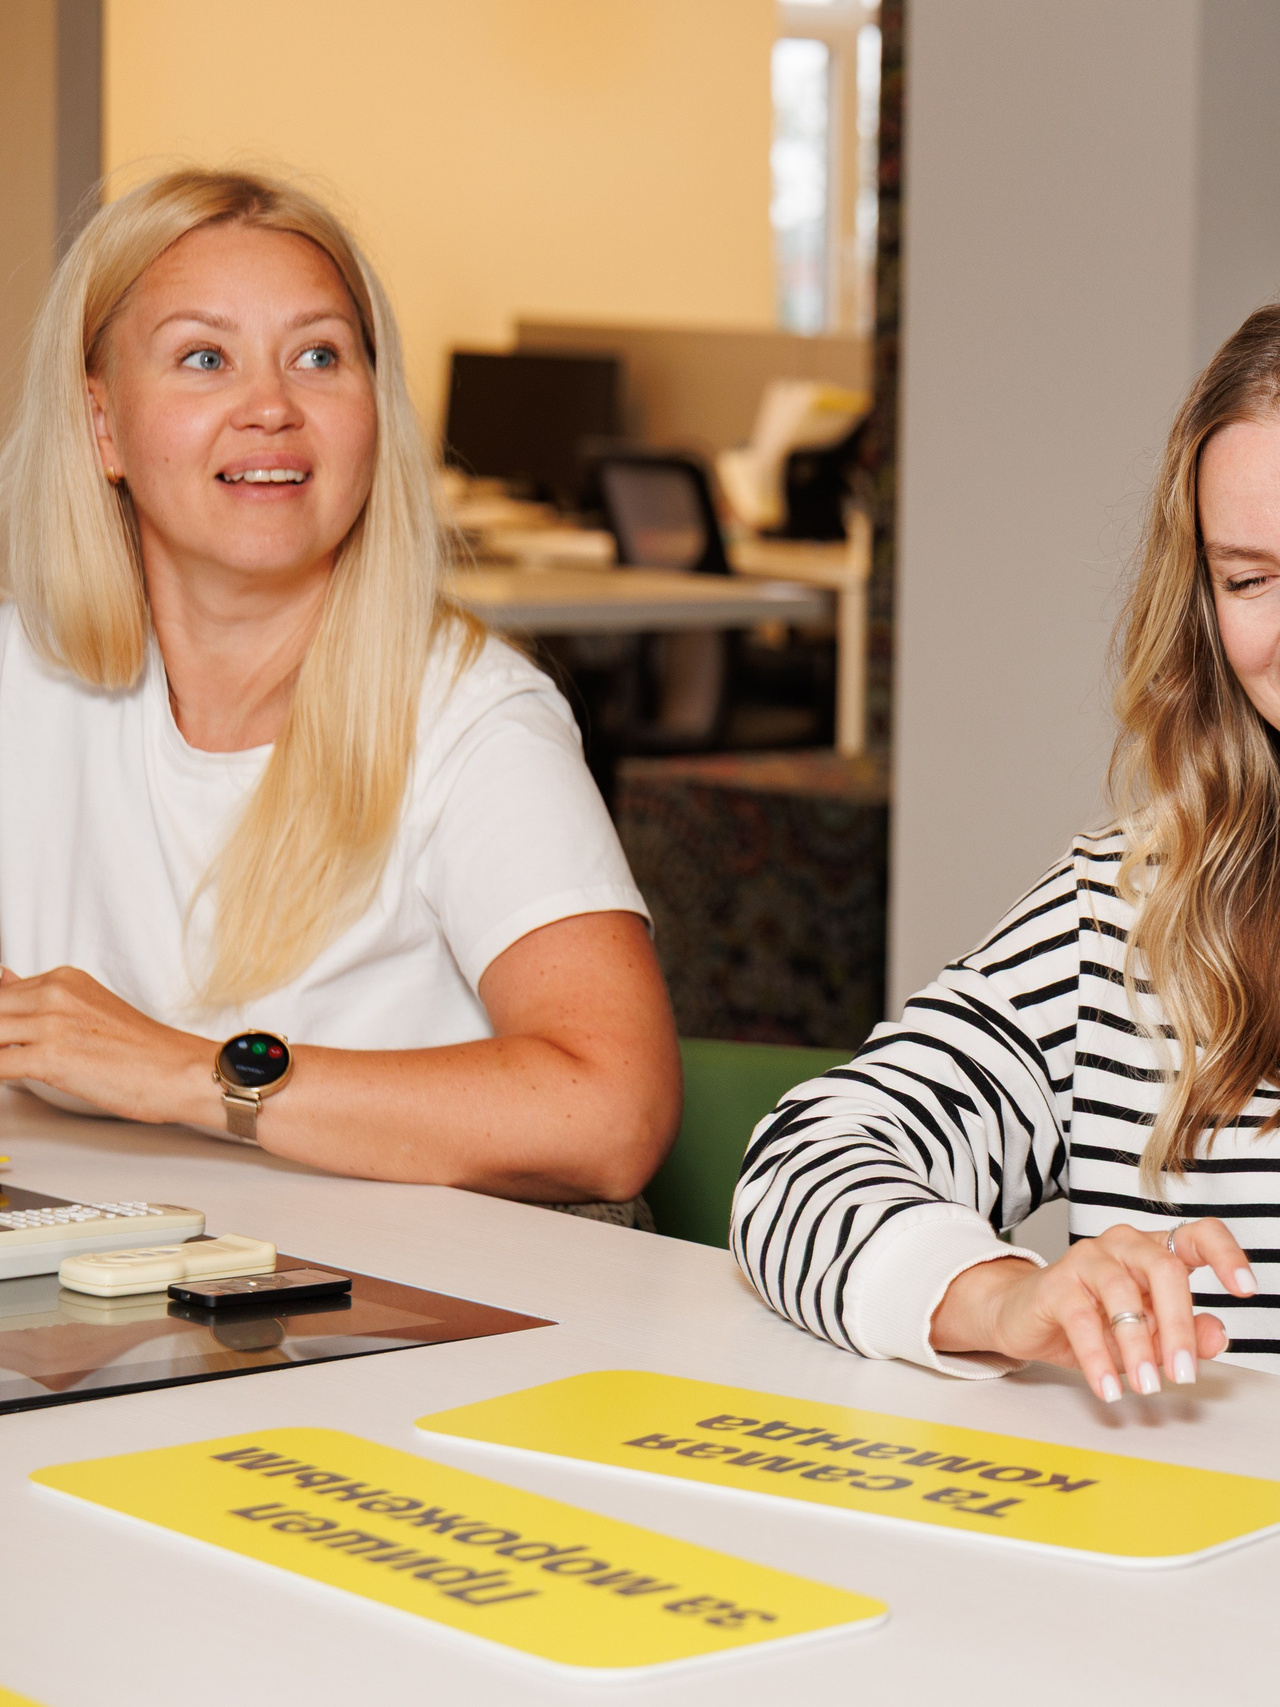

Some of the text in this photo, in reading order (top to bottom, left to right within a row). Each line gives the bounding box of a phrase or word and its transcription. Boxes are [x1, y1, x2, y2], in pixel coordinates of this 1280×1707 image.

[621, 1432, 1026, 1519] Та самая
[693, 1413, 1100, 1493] команда
[208, 1446, 778, 1628] за мороженым
[227, 1501, 543, 1606] Пришел
